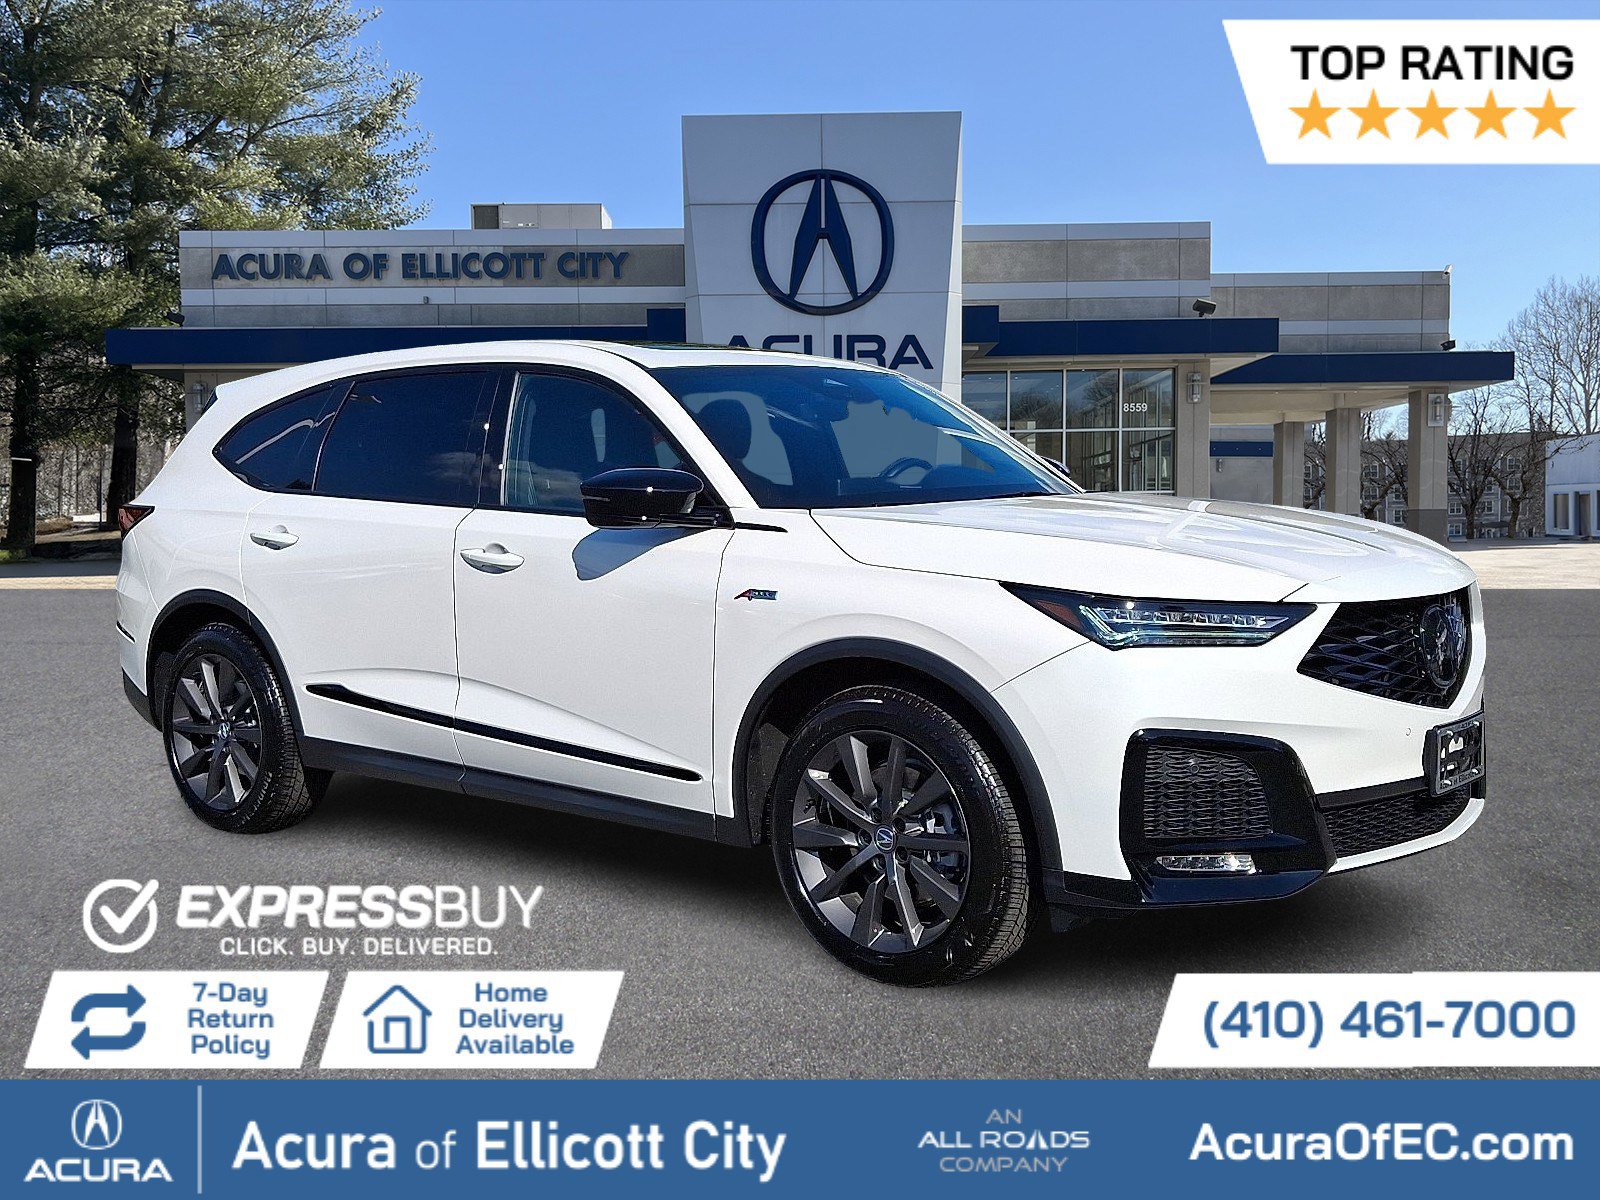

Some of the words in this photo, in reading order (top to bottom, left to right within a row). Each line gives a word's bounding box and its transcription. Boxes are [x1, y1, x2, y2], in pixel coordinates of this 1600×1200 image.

[211, 252, 333, 281] ACURA
[342, 252, 390, 281] OF
[401, 251, 546, 280] ELLICOTT
[556, 251, 630, 280] CITY
[1123, 402, 1148, 412] 8559
